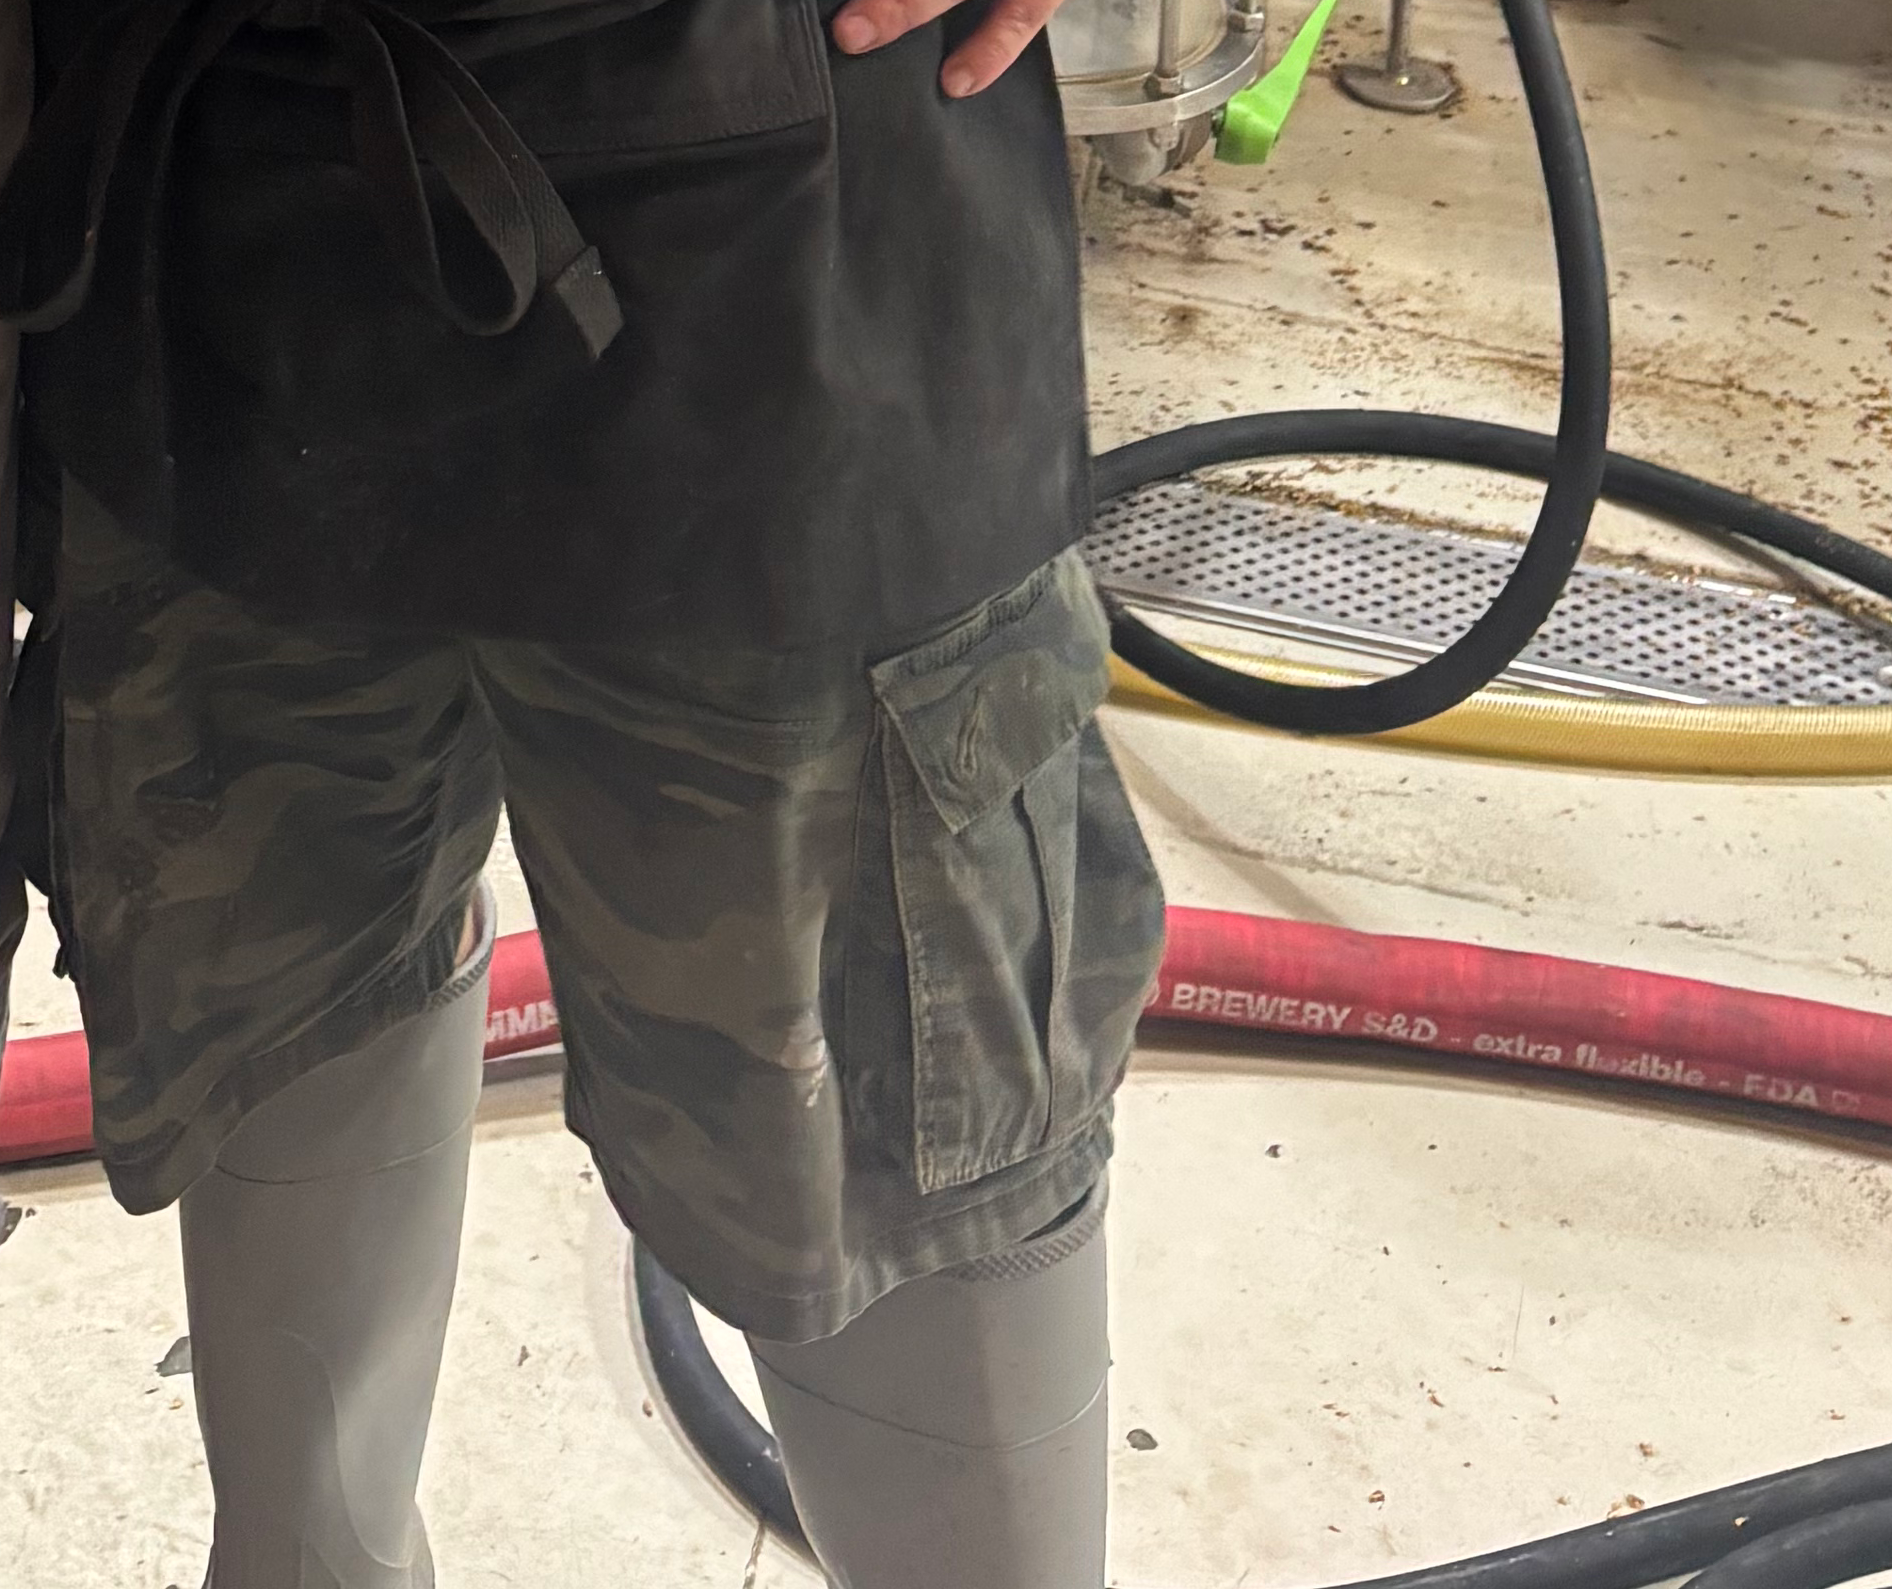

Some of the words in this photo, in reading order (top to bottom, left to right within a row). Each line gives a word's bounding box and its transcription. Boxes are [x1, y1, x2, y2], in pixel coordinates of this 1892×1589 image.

[1171, 982, 1352, 1031] BREWERY
[1361, 1012, 1438, 1042] S&D
[1472, 1032, 1563, 1063] extra
[1742, 1072, 1819, 1108] FDA
